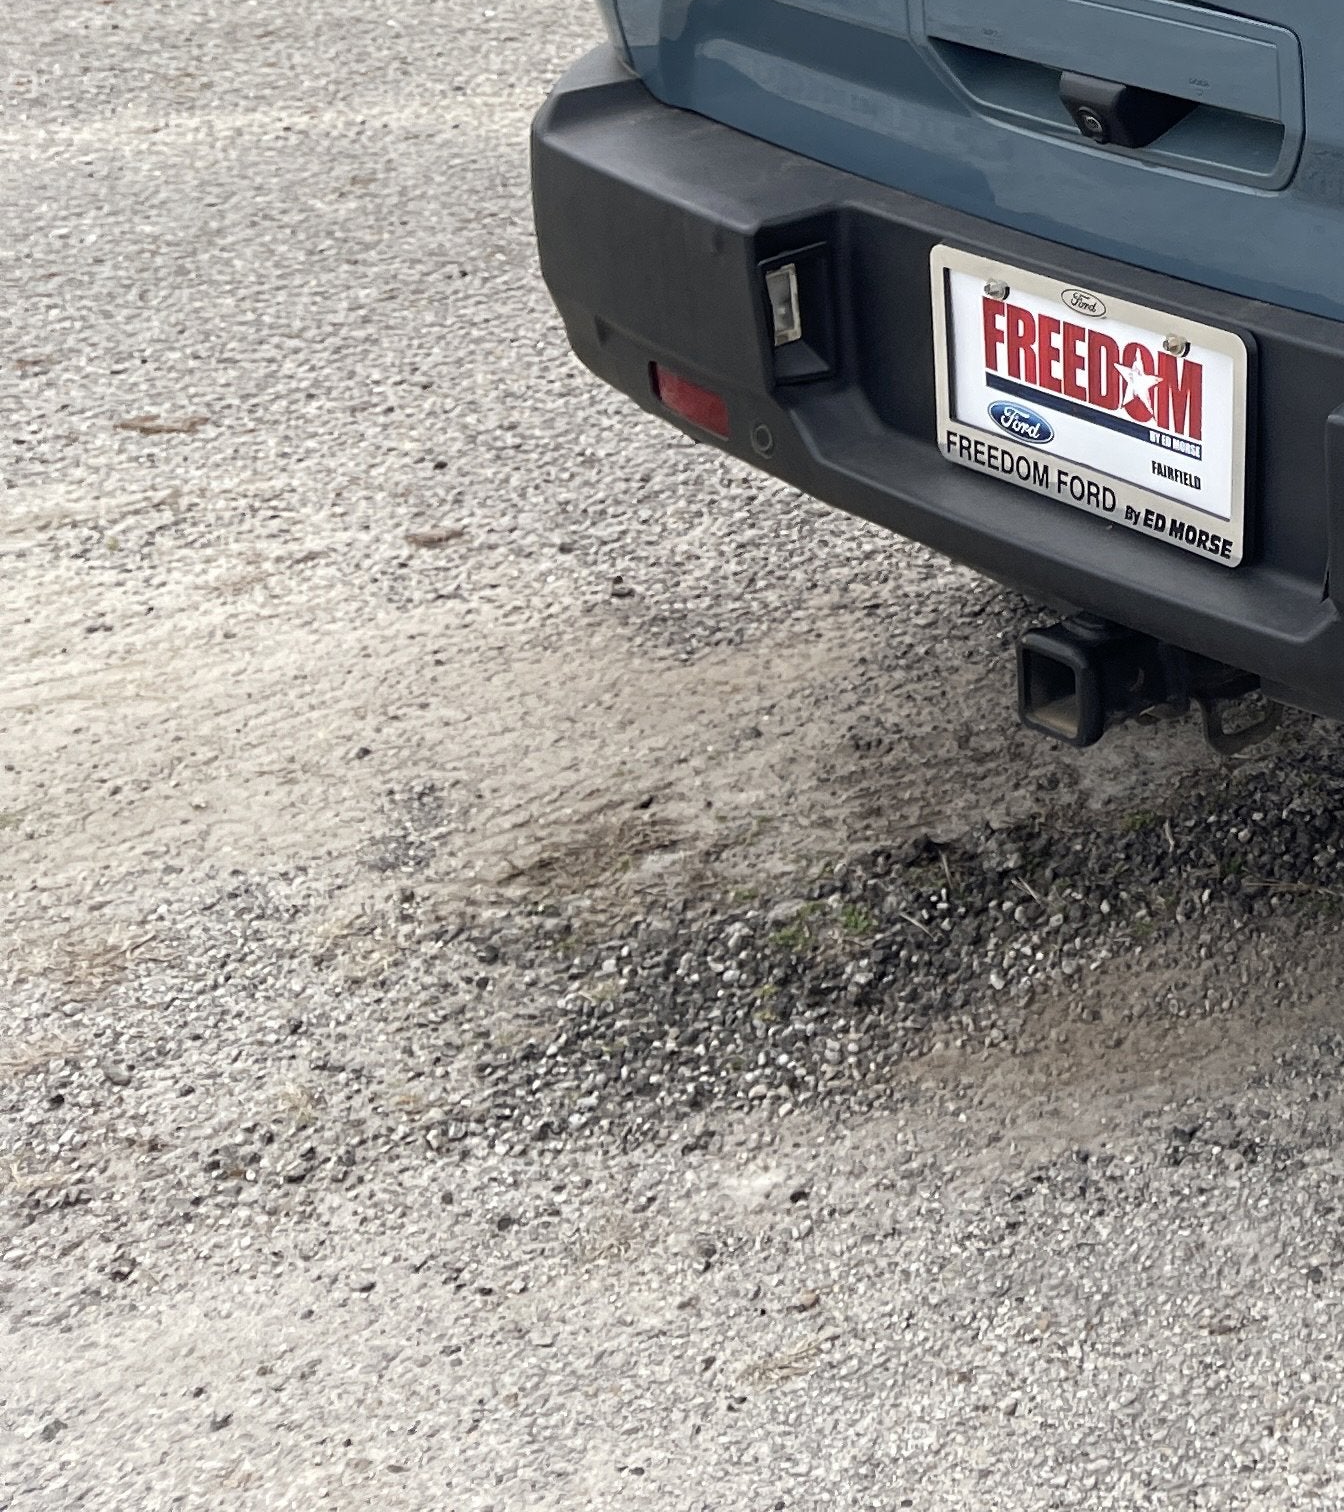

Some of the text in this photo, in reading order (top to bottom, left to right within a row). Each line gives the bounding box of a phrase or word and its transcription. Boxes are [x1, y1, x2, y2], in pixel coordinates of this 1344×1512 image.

[1070, 291, 1097, 313] Ford
[982, 296, 1203, 442] FREEDOM
[999, 405, 1041, 439] Ford
[1172, 437, 1202, 459] MORSE
[1151, 459, 1202, 490] FAIRFIELD
[946, 430, 1234, 560] FREEDOM FORD By ED MORSE
